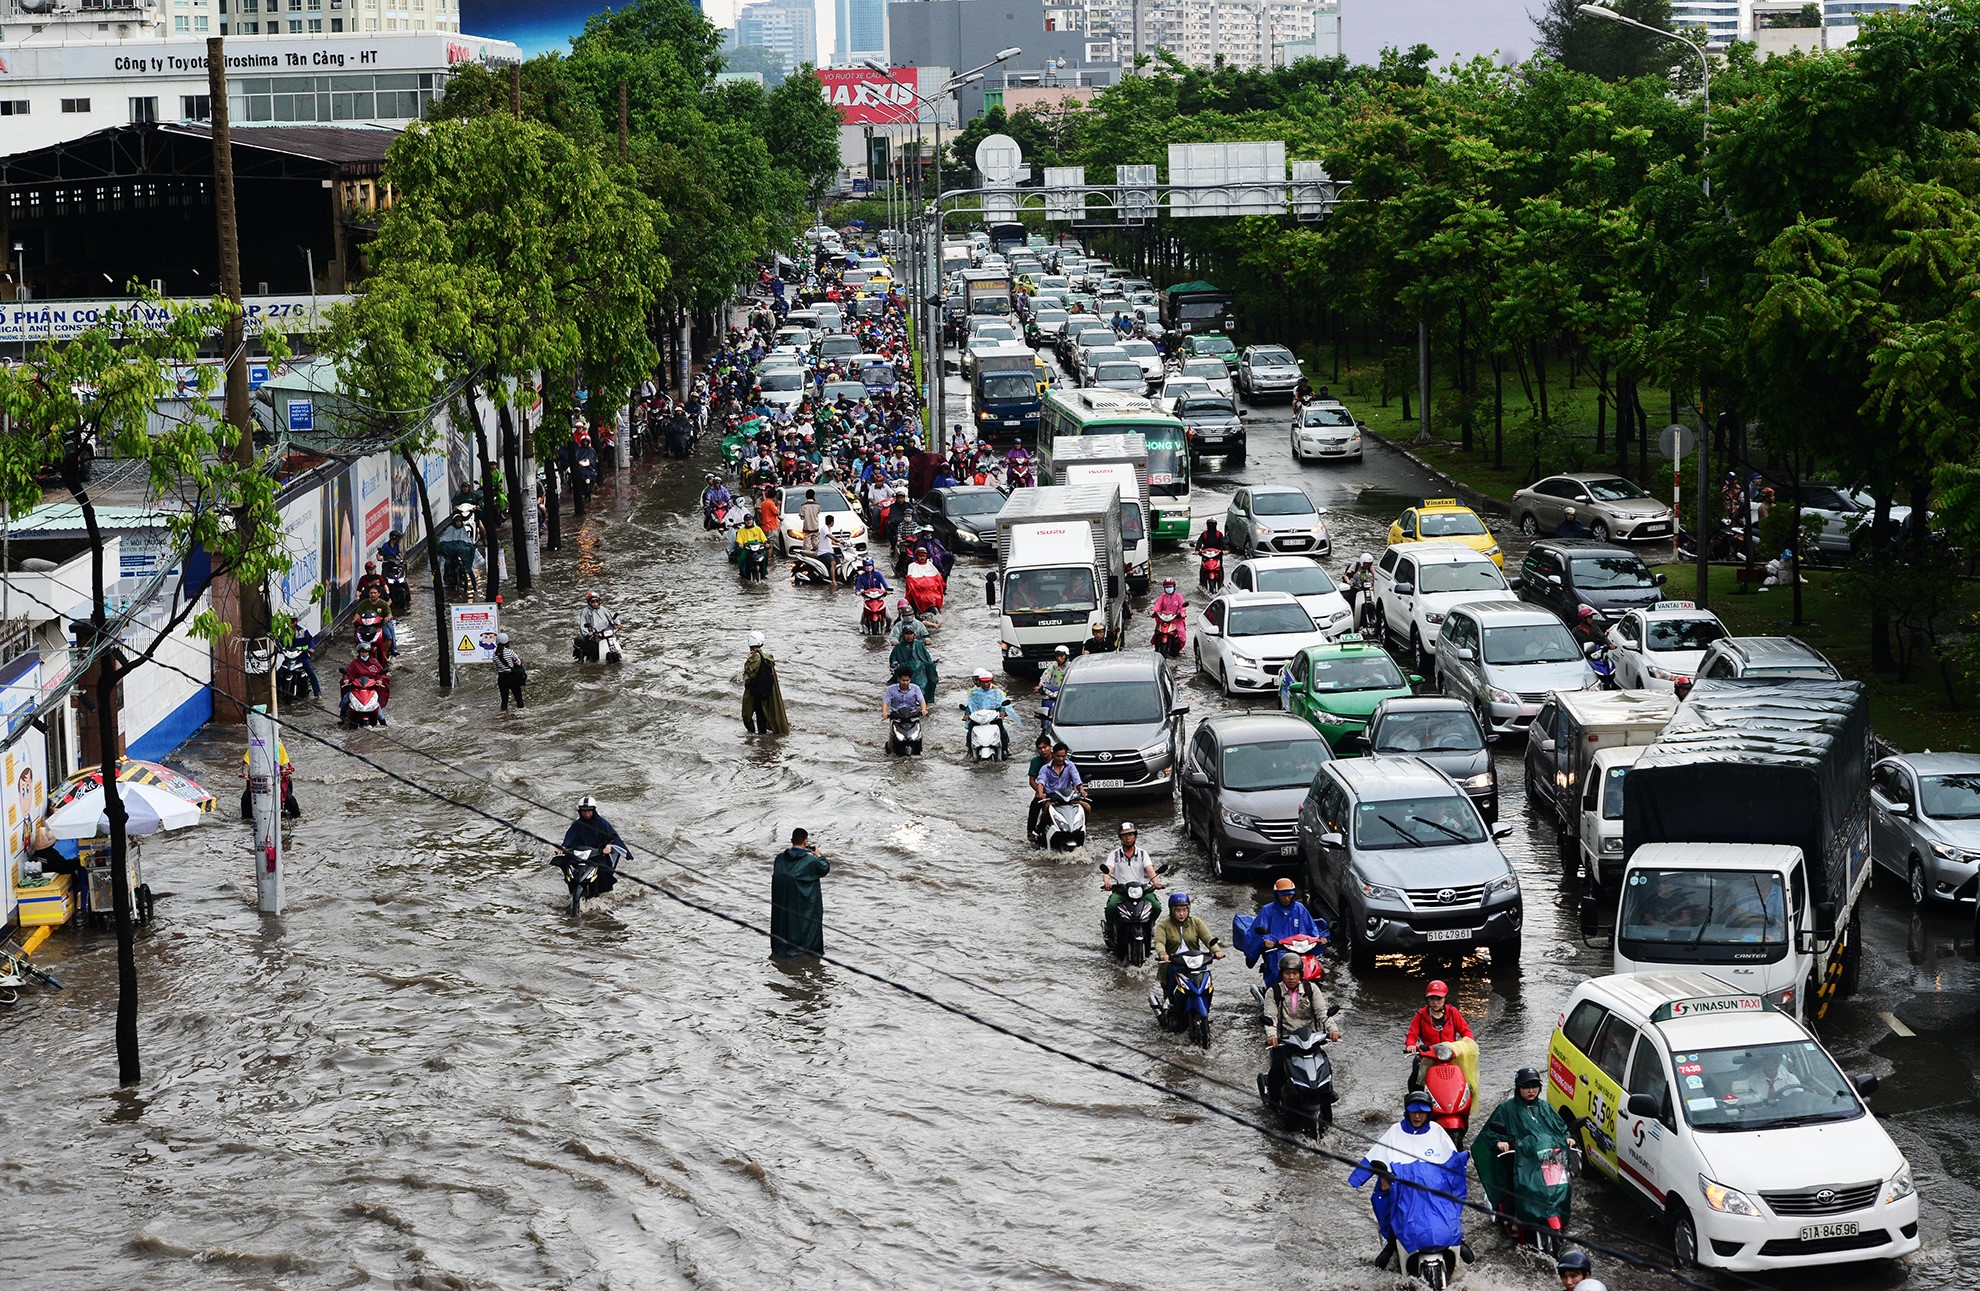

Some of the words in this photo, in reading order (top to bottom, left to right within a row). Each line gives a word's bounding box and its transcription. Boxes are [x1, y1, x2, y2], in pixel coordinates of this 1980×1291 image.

[115, 56, 146, 72] Công
[151, 56, 163, 72] ty
[168, 55, 210, 71] Toyota
[223, 54, 278, 68] iroshima
[285, 52, 307, 66] Tân
[312, 50, 345, 67] Cảng
[361, 51, 378, 64] HT
[0, 306, 6, 325] Ổ
[14, 306, 66, 324] PHẦN
[73, 308, 99, 323] CƠ
[268, 304, 304, 317] 276
[0, 325, 23, 333] ICAL
[1692, 1000, 1738, 1012] VINASUN
[1739, 999, 1760, 1009] TAXI
[1588, 1091, 1615, 1132] 15.5%
